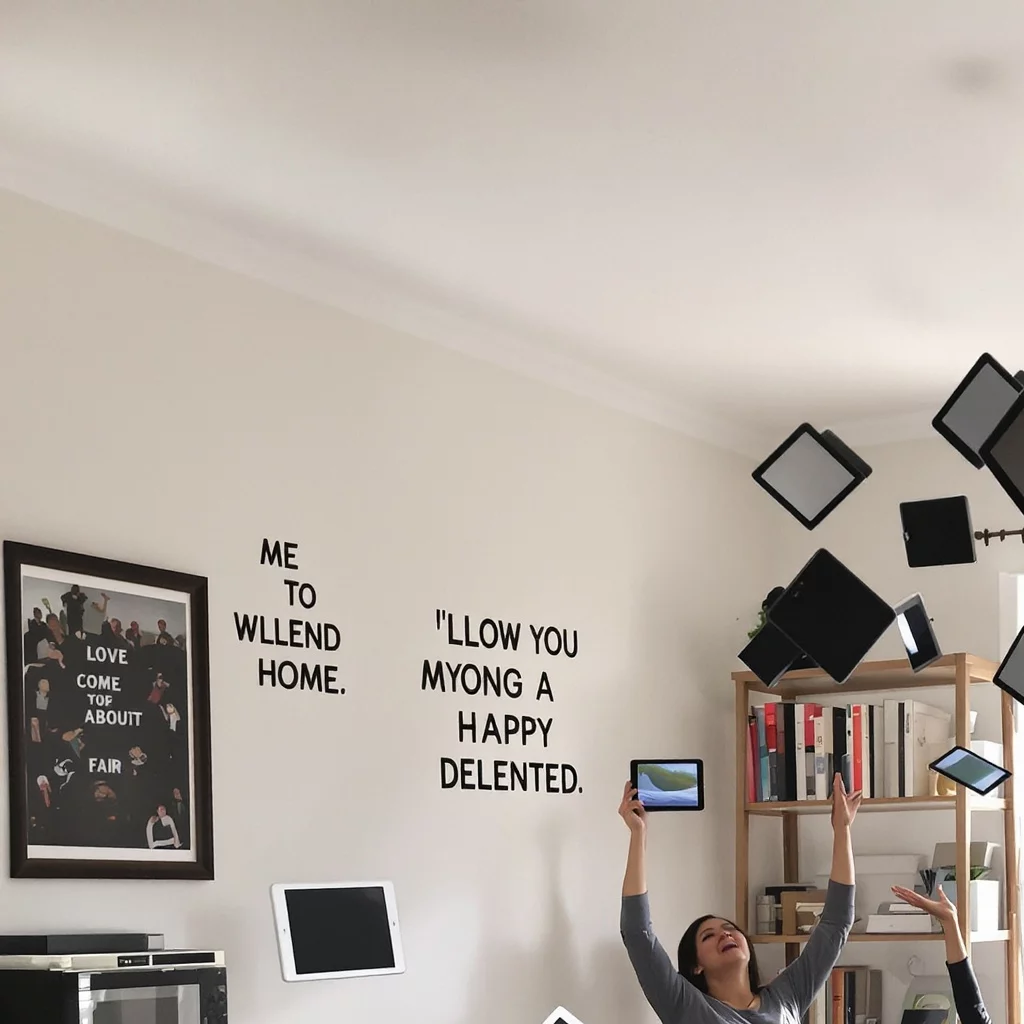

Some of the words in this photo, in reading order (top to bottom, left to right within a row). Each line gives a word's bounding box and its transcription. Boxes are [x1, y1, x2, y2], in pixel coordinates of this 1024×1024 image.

[260, 538, 299, 570] ME
[284, 579, 317, 609] TO
[233, 611, 341, 651] WLLEND
[529, 624, 578, 658] YOU
[86, 645, 128, 665] LOVE
[76, 673, 122, 692] COME
[258, 658, 346, 695] HOME.
[421, 659, 523, 699] MYONG
[536, 671, 554, 702] A
[458, 710, 553, 748] HAPPY
[88, 758, 122, 774] FAIR
[440, 757, 583, 794] DELENTED.
